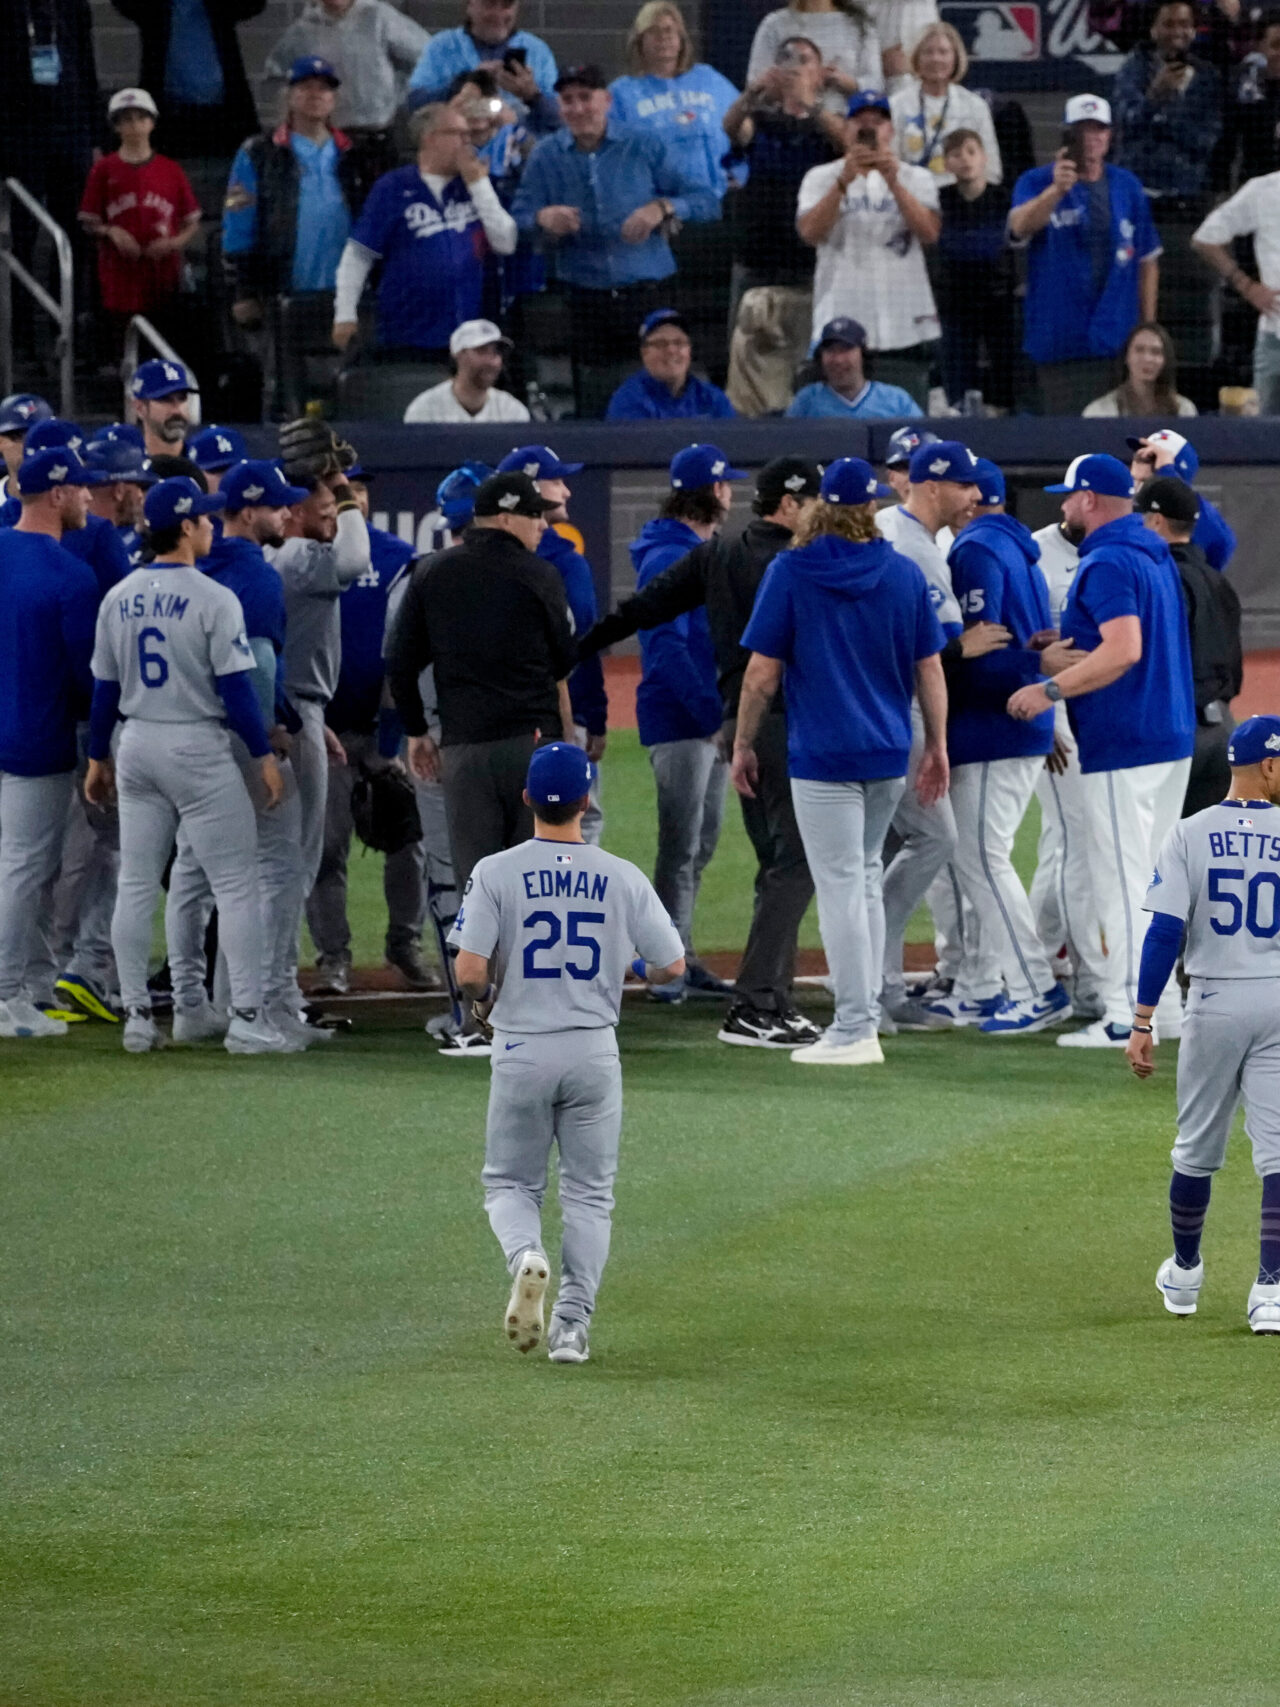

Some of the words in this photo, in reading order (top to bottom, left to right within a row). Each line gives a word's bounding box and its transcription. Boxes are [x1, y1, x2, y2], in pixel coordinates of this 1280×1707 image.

[152, 593, 190, 621] KIM
[138, 627, 169, 688] 6
[522, 870, 609, 902] EDMAN
[523, 911, 606, 981] 25
